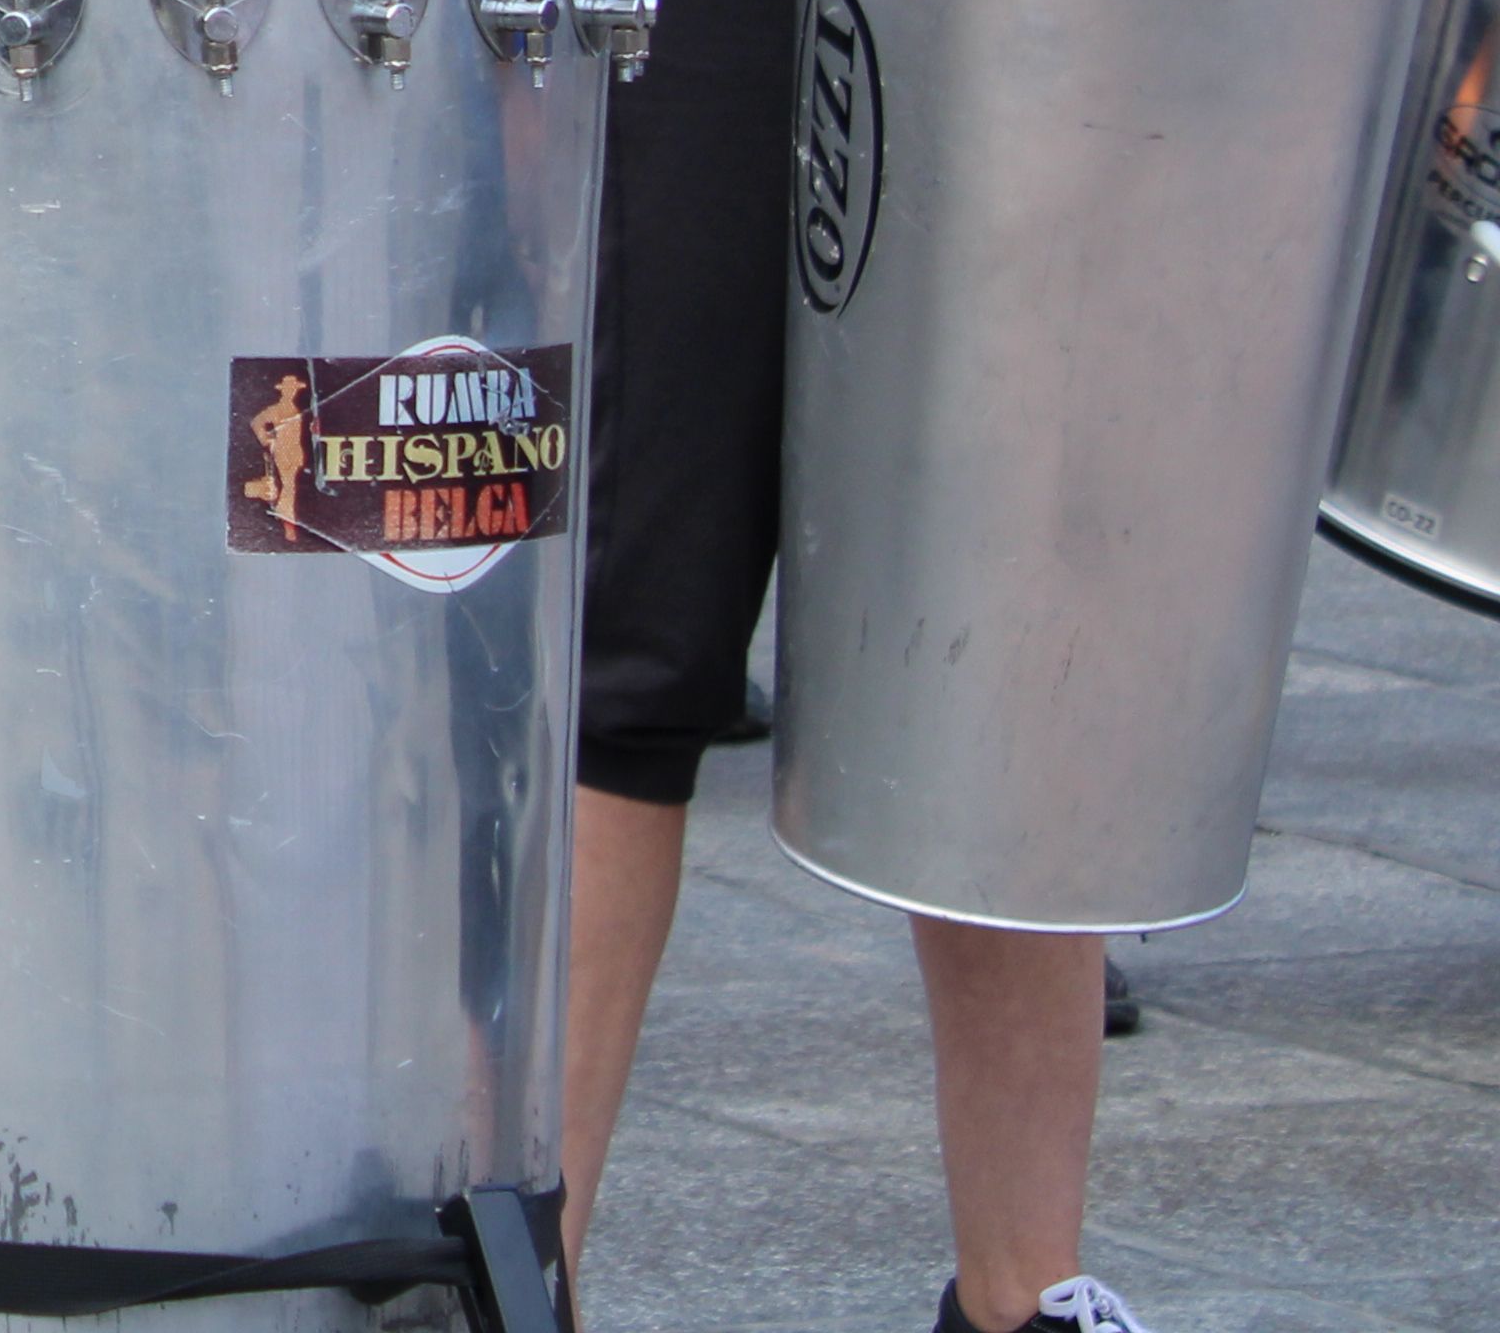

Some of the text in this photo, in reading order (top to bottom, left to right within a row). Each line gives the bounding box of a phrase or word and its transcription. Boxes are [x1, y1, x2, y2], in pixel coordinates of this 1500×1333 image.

[379, 368, 537, 427] RUMBA
[320, 424, 566, 484] HISPANO
[384, 483, 531, 541] BELGA
